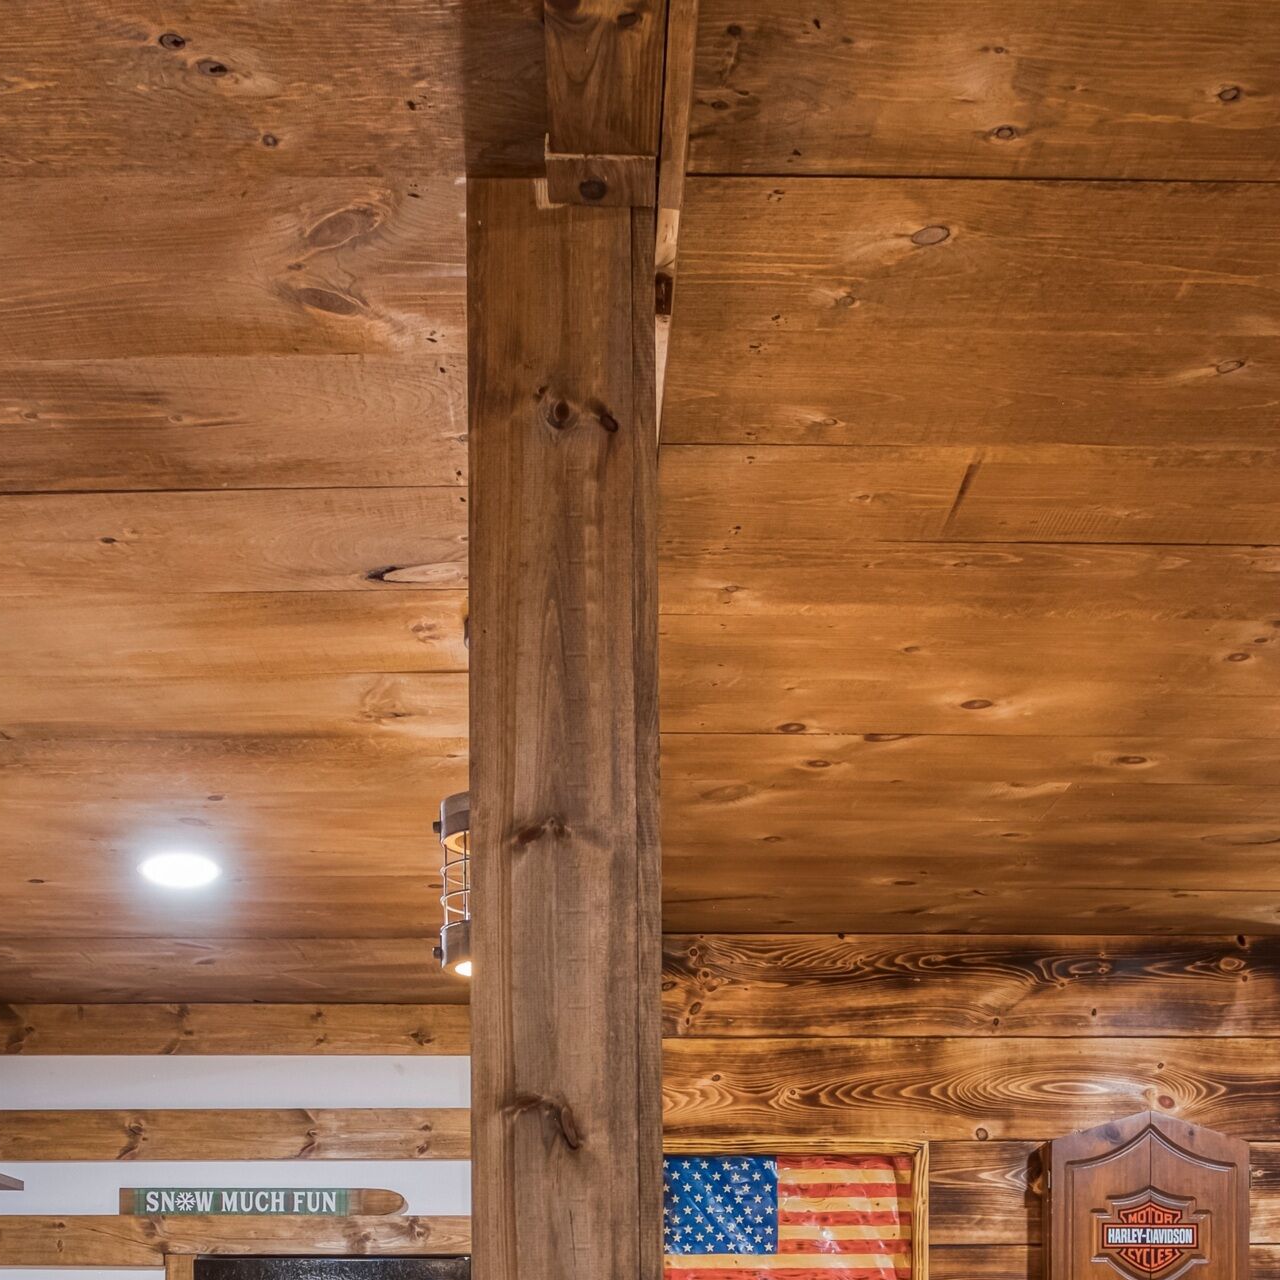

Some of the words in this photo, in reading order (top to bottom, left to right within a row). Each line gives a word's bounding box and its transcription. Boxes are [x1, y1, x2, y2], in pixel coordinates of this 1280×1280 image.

[221, 1191, 285, 1212] MUCH
[293, 1191, 336, 1212] FUN
[1128, 1206, 1173, 1224] MOTOR
[1108, 1228, 1193, 1244] HARLEY-DAVIDSON
[1128, 1248, 1173, 1268] CYCLES
